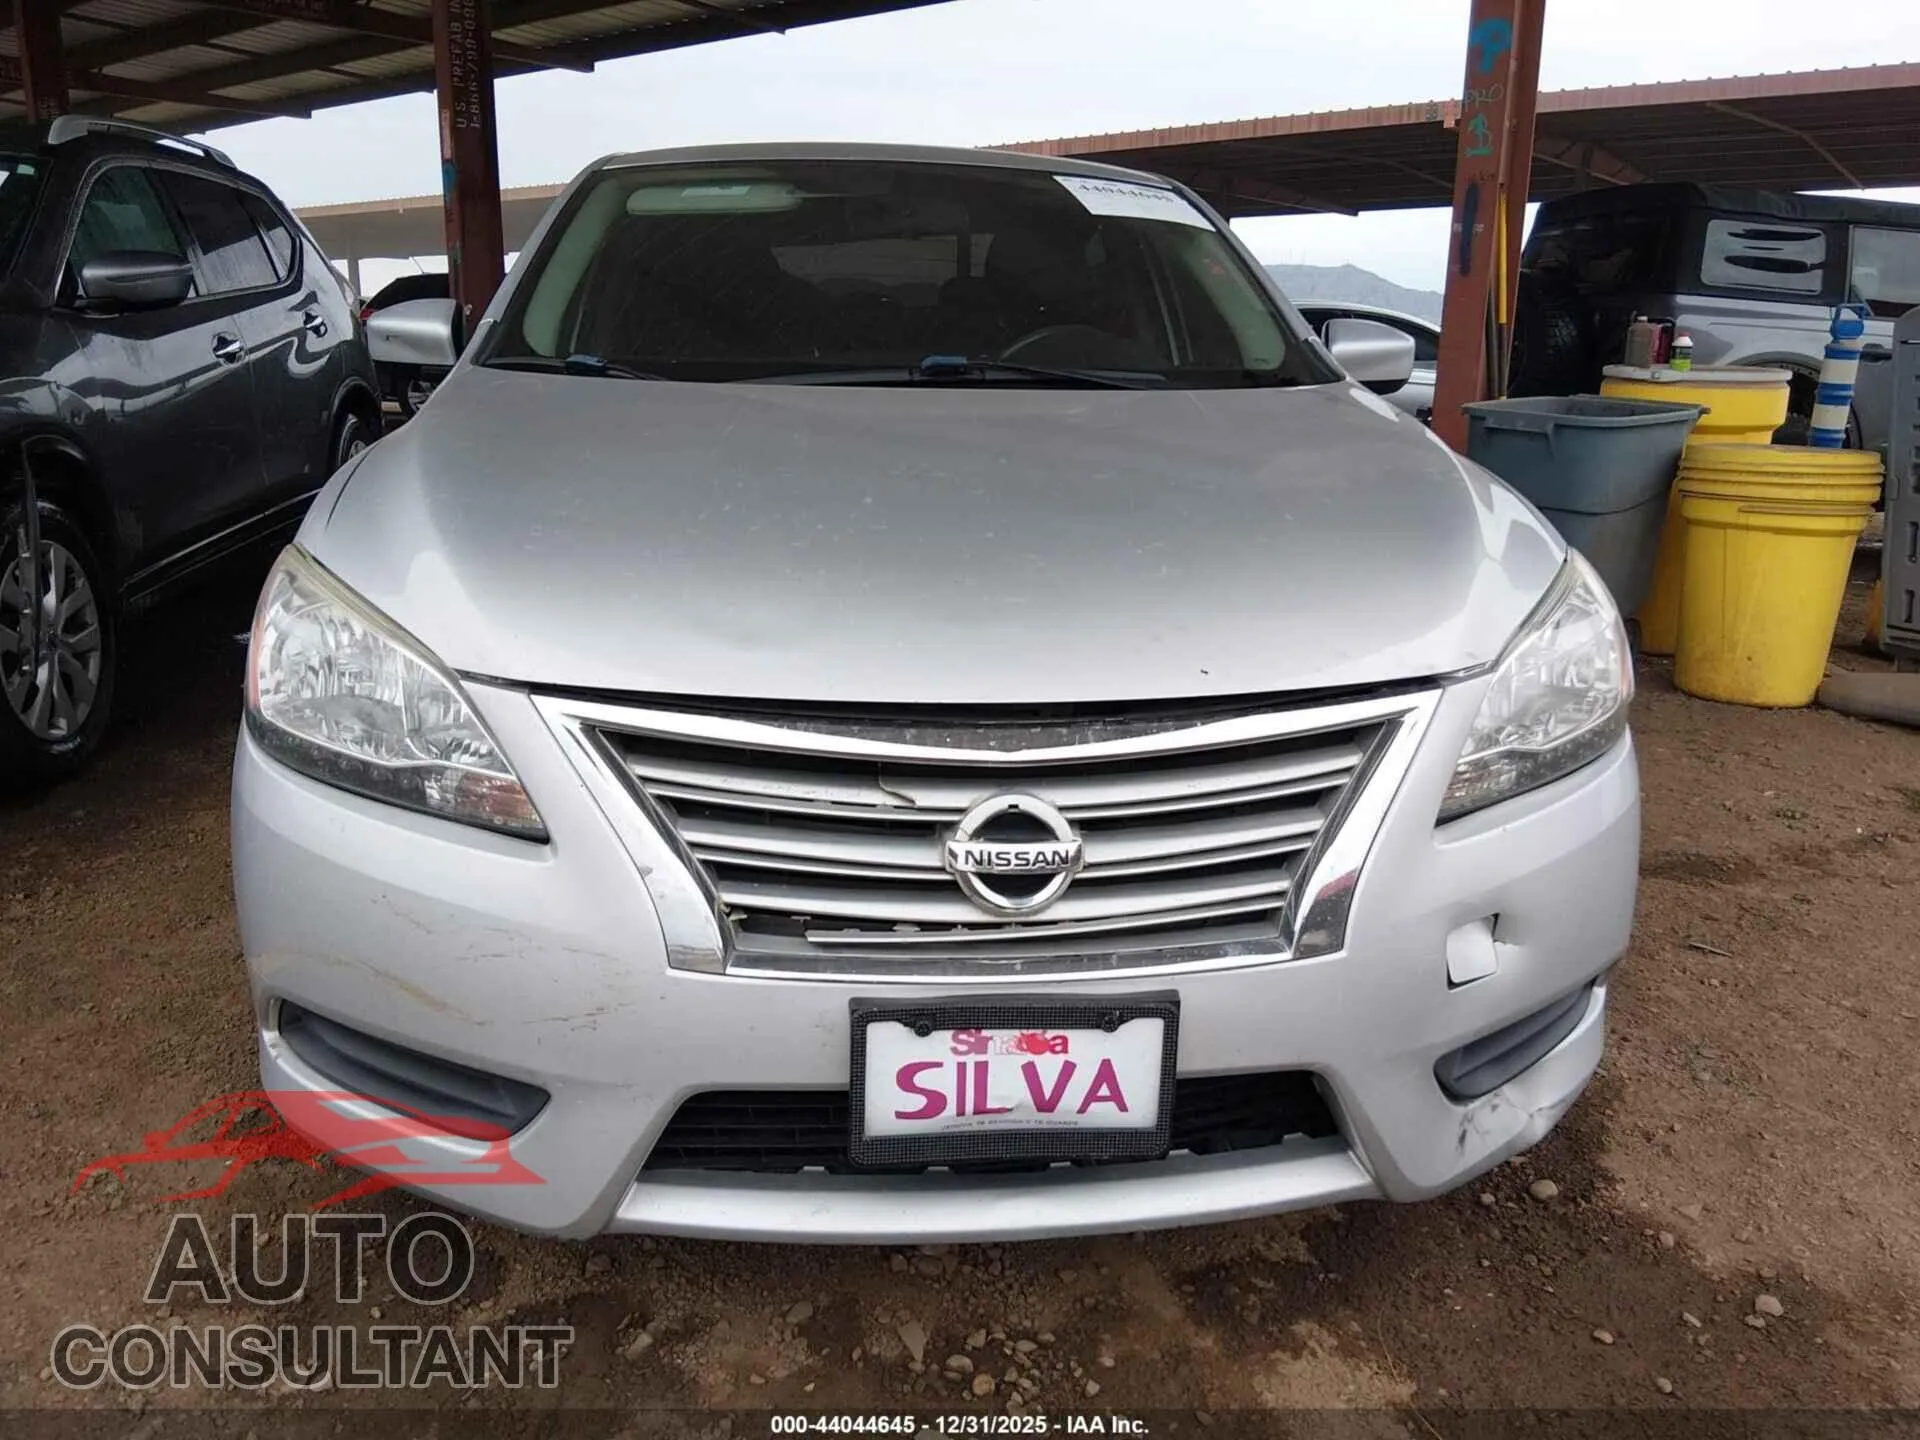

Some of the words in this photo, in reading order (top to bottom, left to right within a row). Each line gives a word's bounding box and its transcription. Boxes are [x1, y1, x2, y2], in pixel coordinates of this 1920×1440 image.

[450, 21, 464, 87] PREFAB
[964, 849, 1069, 868] NISSAN
[895, 1058, 1129, 1120] SILVA
